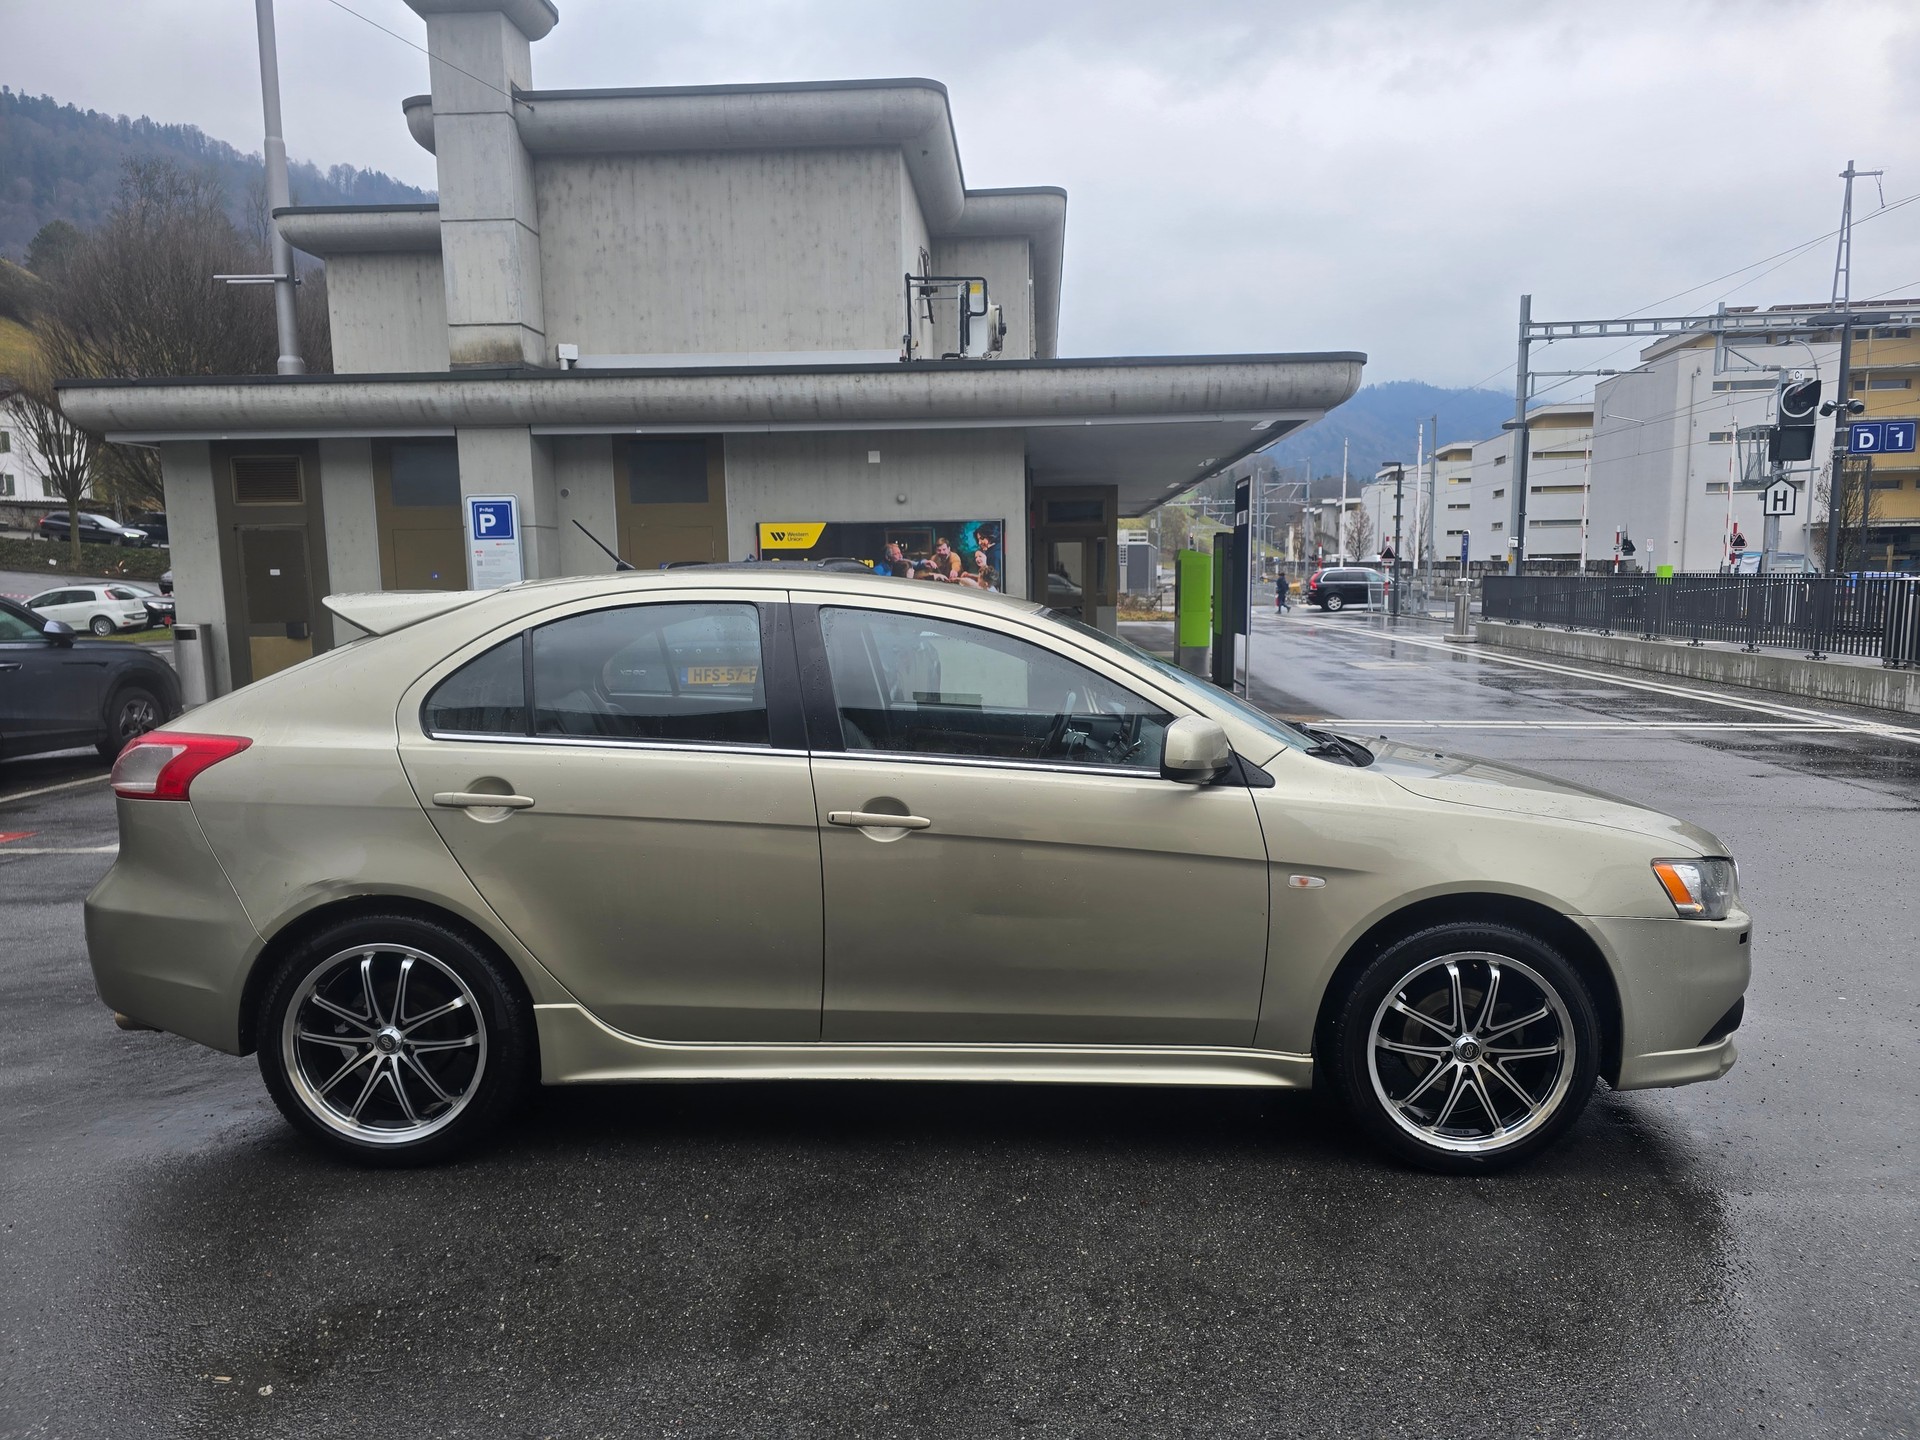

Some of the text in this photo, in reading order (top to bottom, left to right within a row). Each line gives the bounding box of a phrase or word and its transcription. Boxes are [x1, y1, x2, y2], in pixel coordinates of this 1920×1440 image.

[1859, 432, 1874, 449] D
[1895, 431, 1904, 447] 1
[1772, 490, 1788, 511] H
[480, 514, 496, 534] P
